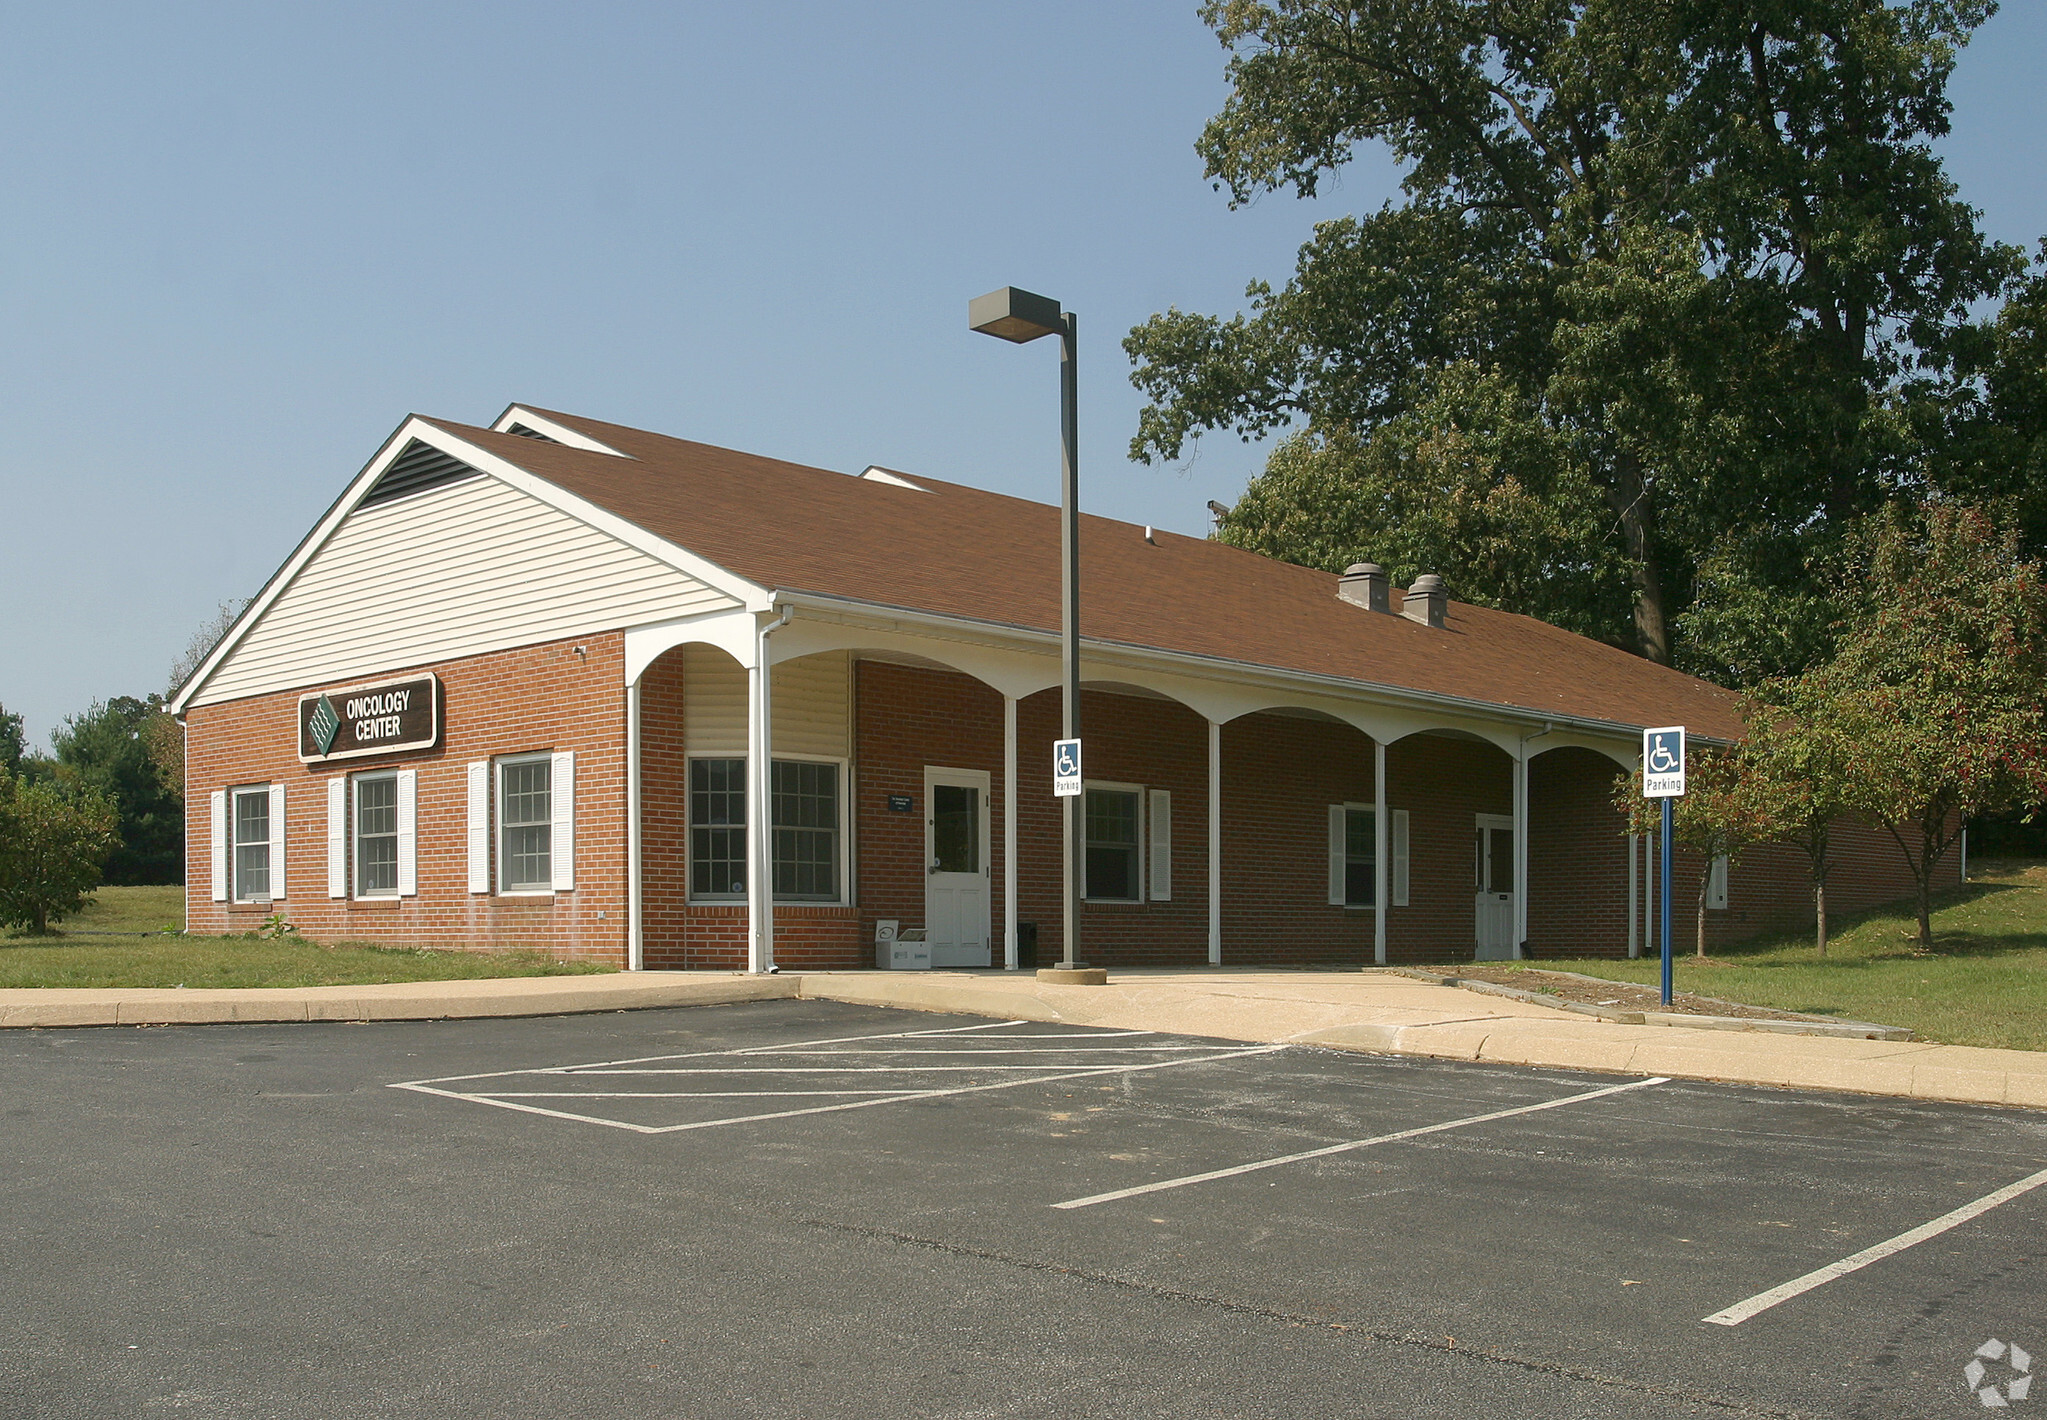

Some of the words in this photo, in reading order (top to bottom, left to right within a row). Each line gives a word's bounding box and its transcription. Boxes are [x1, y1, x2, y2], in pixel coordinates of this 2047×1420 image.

[346, 690, 410, 719] ONCOLOGY
[355, 715, 401, 741] CENTER
[1056, 780, 1079, 792] Parking
[1647, 778, 1681, 791] Parking
